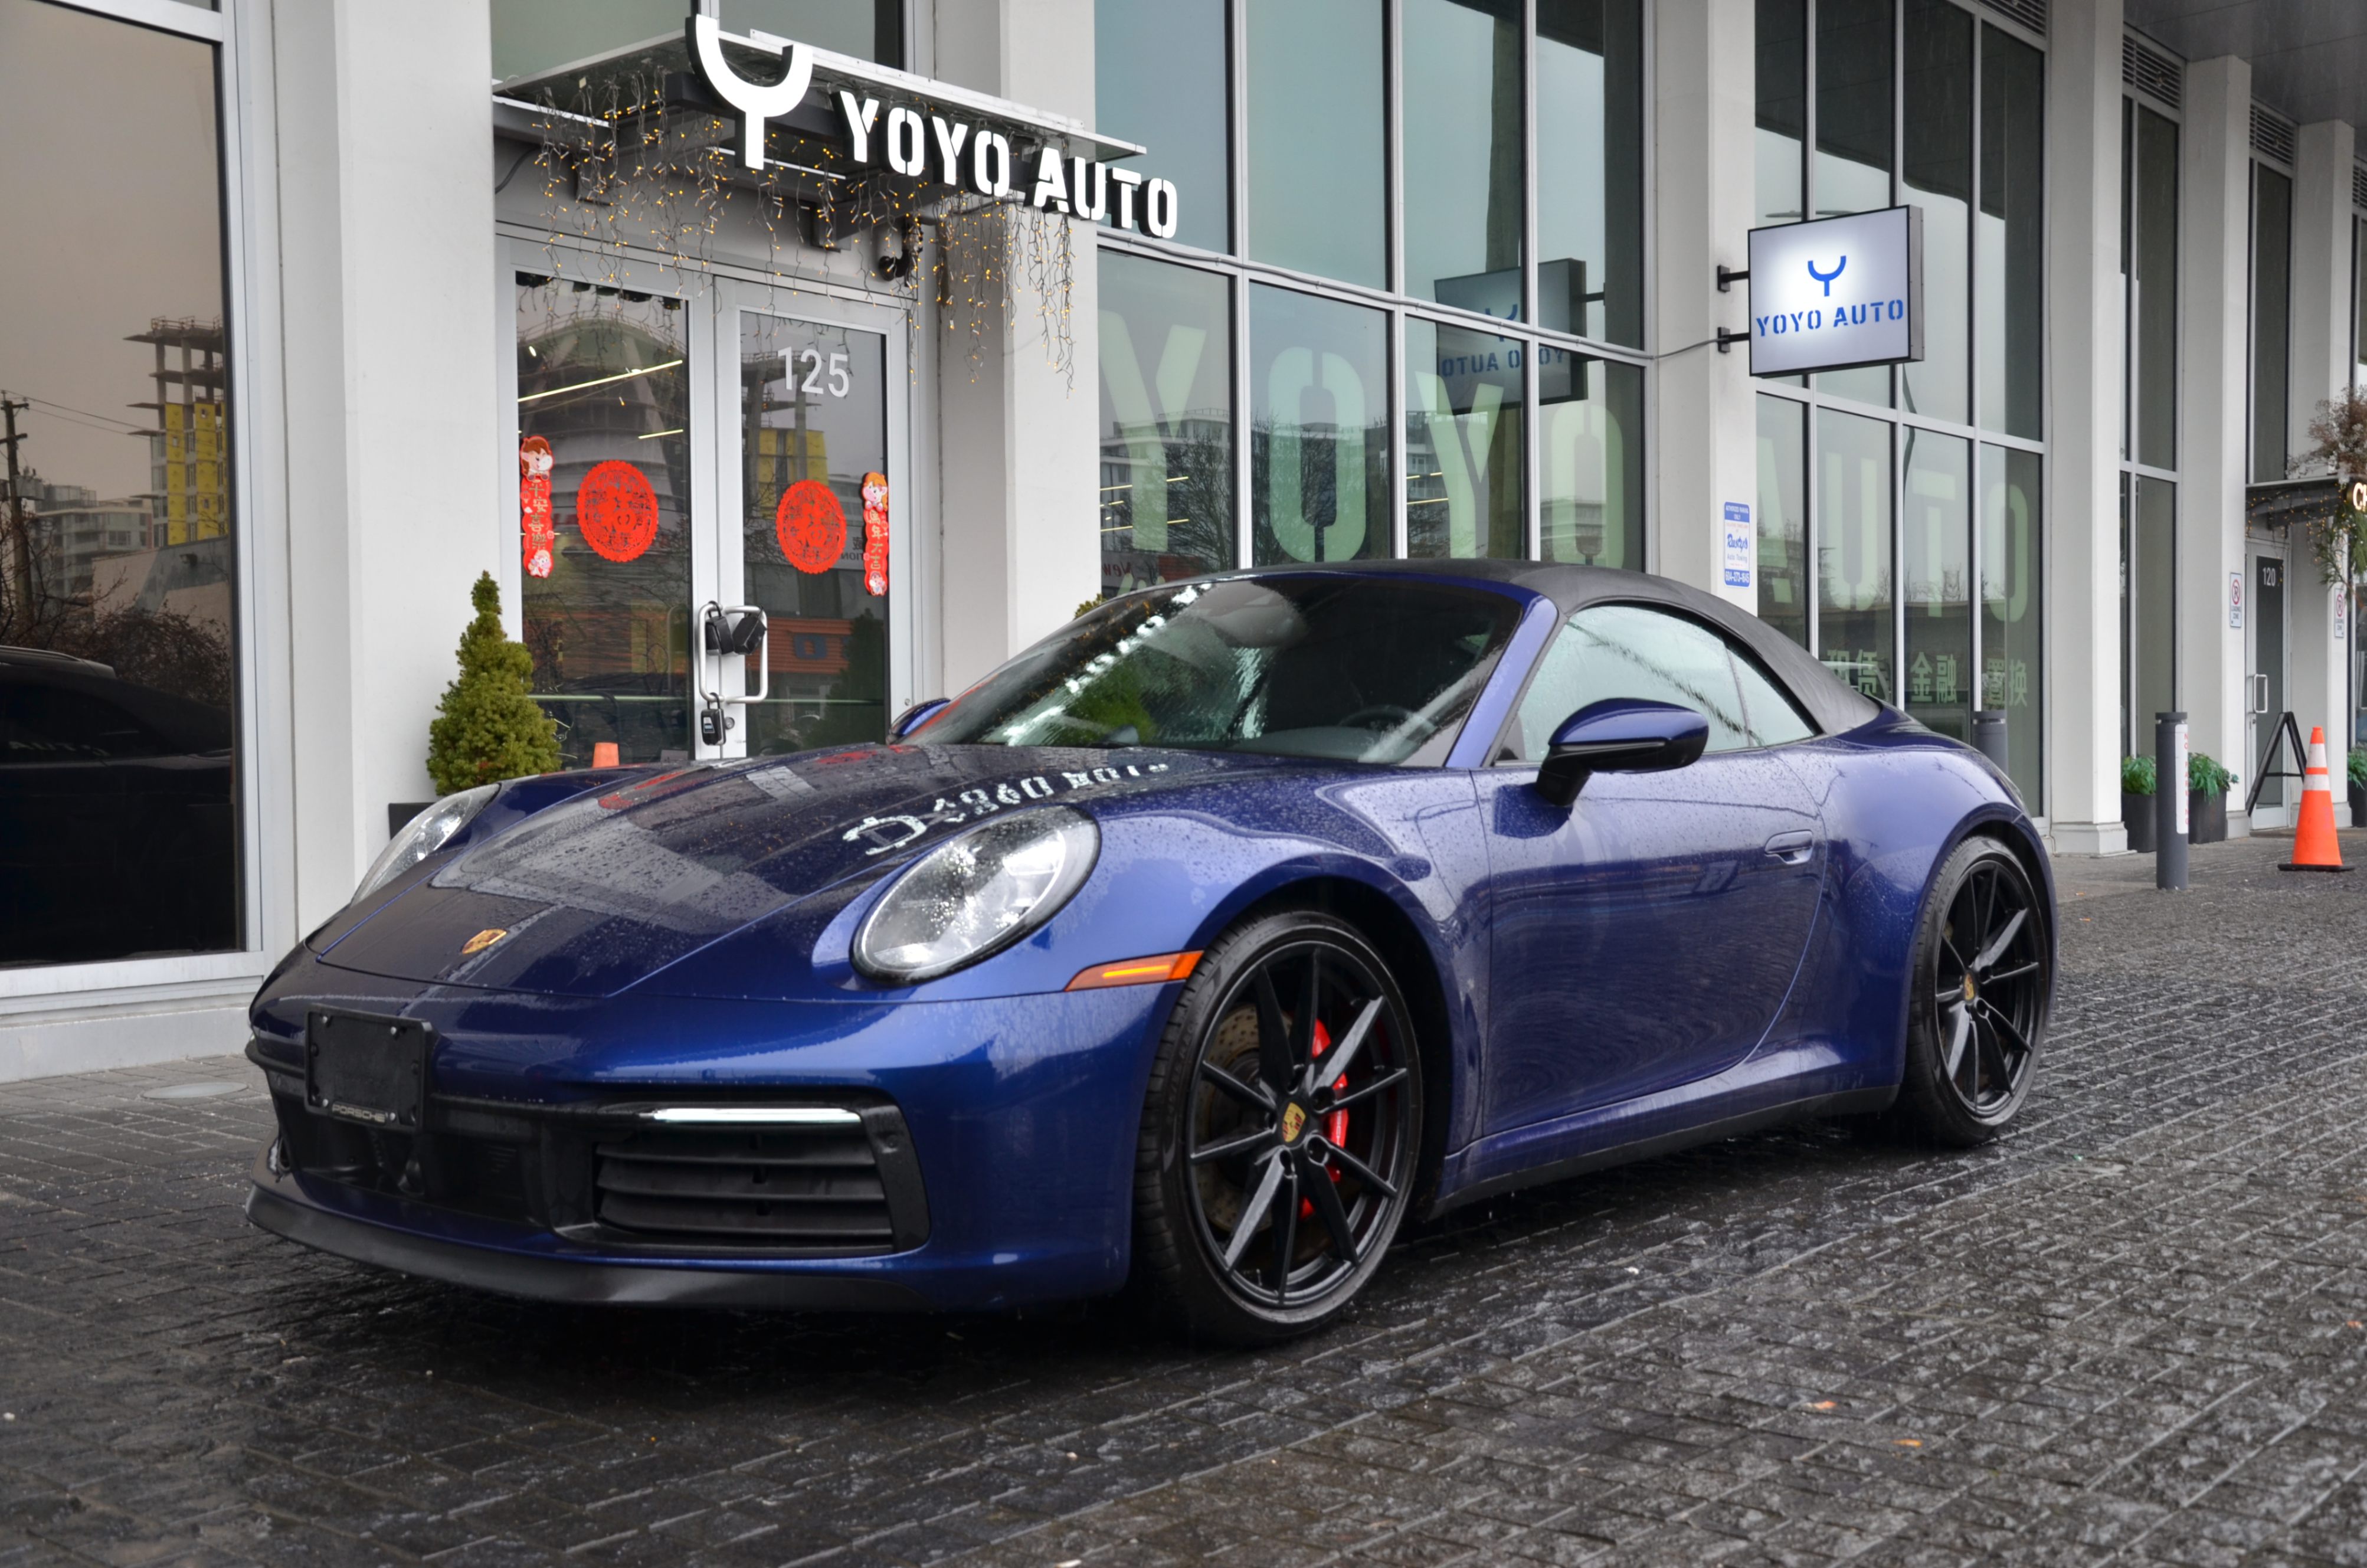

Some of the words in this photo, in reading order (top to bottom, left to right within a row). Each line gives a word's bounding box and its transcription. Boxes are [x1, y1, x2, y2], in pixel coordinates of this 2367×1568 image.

[836, 90, 1011, 197] YOYO
[1033, 148, 1178, 239] AUTO
[1756, 310, 1822, 336] YOYO
[1833, 299, 1904, 328] AUTO
[777, 346, 850, 398] 125
[1098, 310, 1624, 568] YOYO
[2263, 567, 2276, 587] 120
[1910, 652, 1957, 704] 金融
[332, 1104, 385, 1123] PORSCHE
